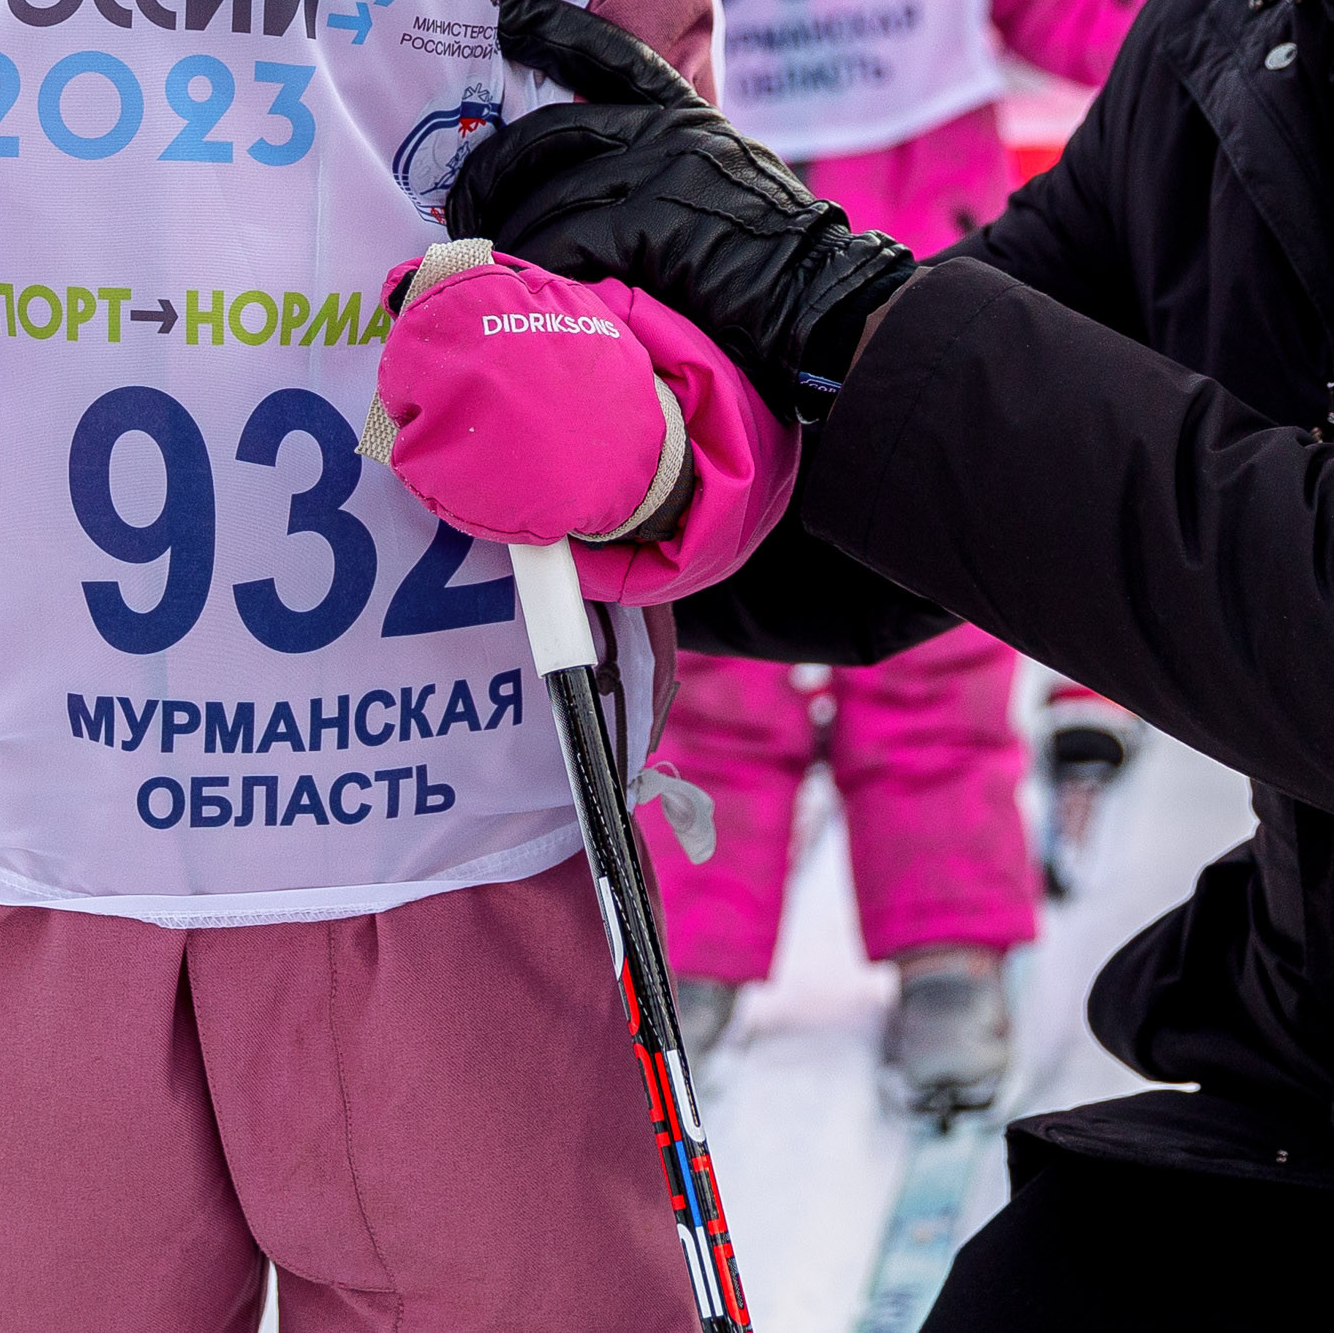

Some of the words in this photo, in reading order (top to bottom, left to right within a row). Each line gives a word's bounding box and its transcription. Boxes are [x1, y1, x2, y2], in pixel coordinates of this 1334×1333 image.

[482, 312, 621, 339] DIDRIKSONS
[68, 385, 516, 655] 932
[66, 667, 524, 754] МУРМАНСКАЯ
[136, 763, 457, 830] ОБЛАСТЬ
